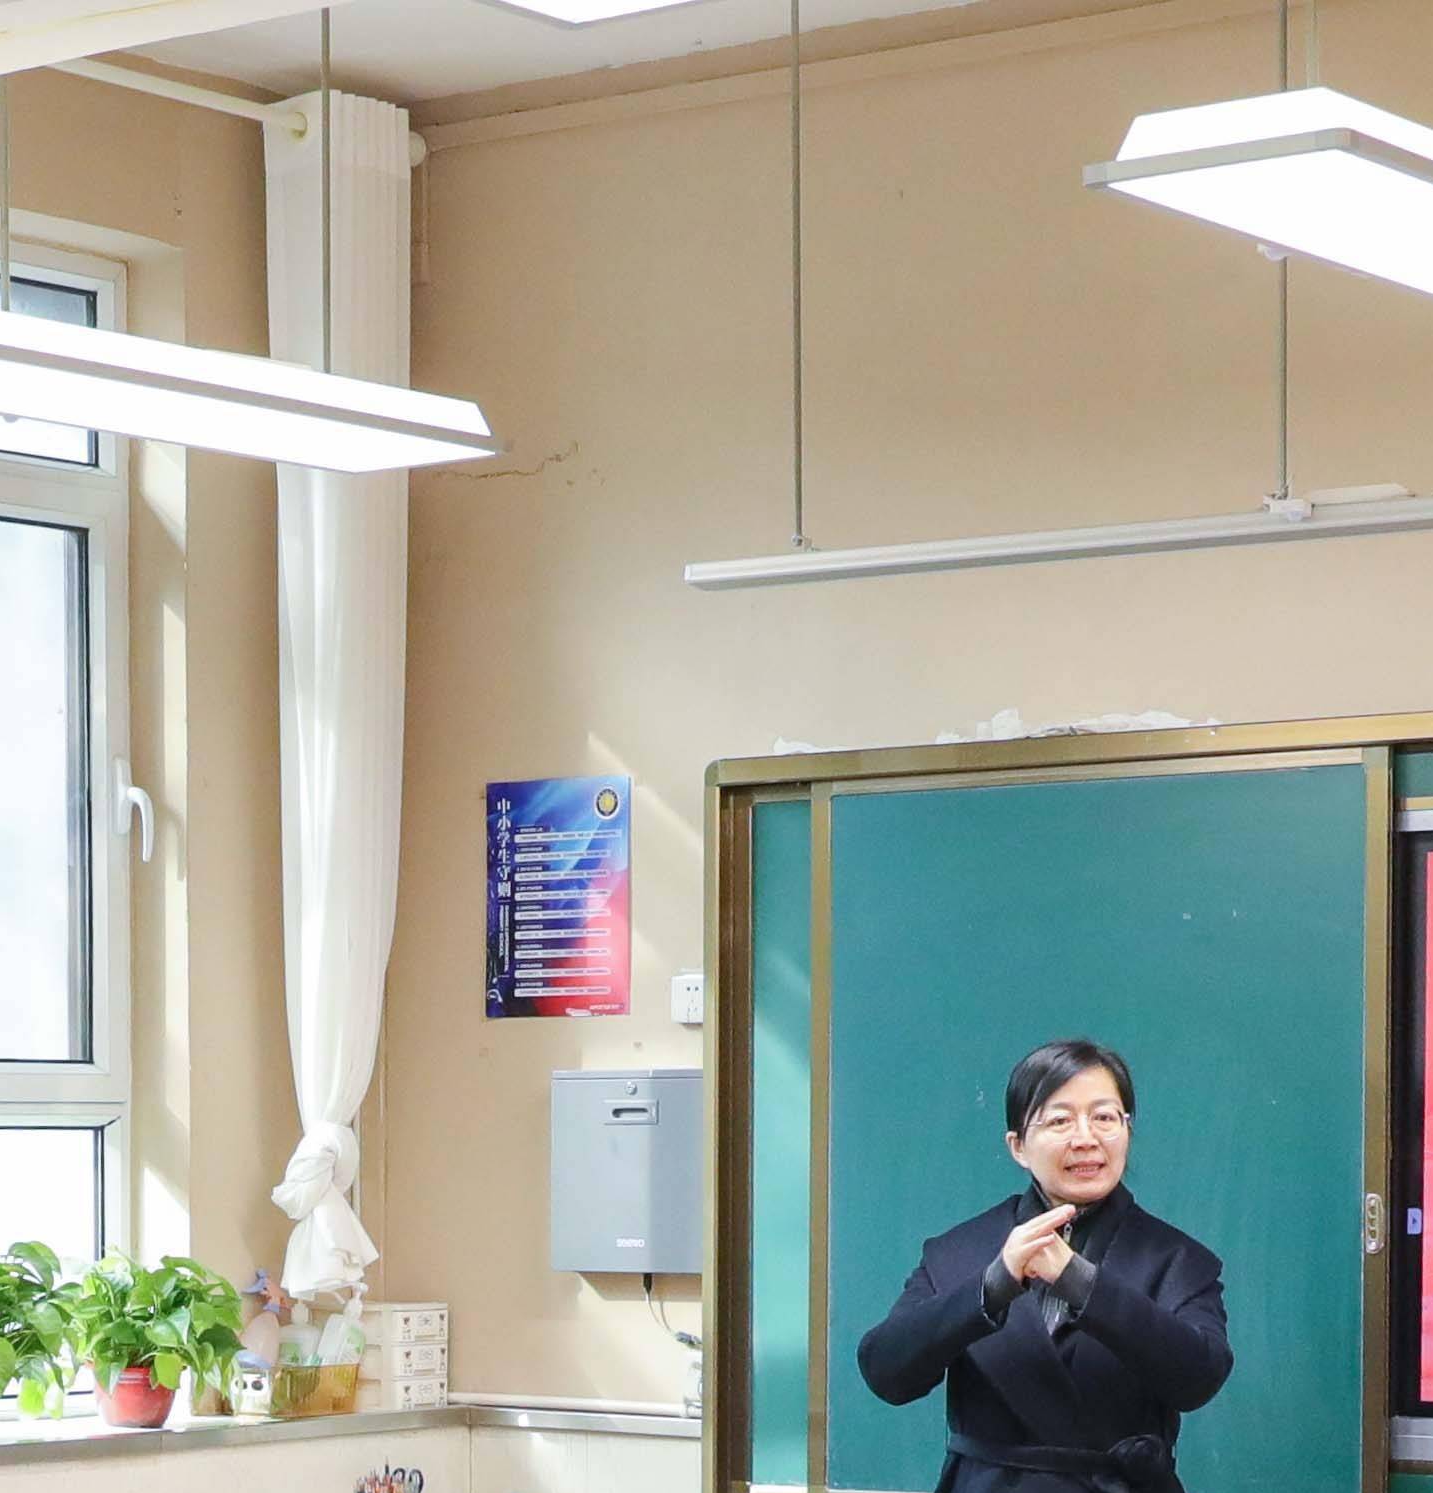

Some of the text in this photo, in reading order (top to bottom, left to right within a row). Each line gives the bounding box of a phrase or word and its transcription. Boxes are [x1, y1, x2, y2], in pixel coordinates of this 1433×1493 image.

[496, 798, 512, 898] 中小学生守则
